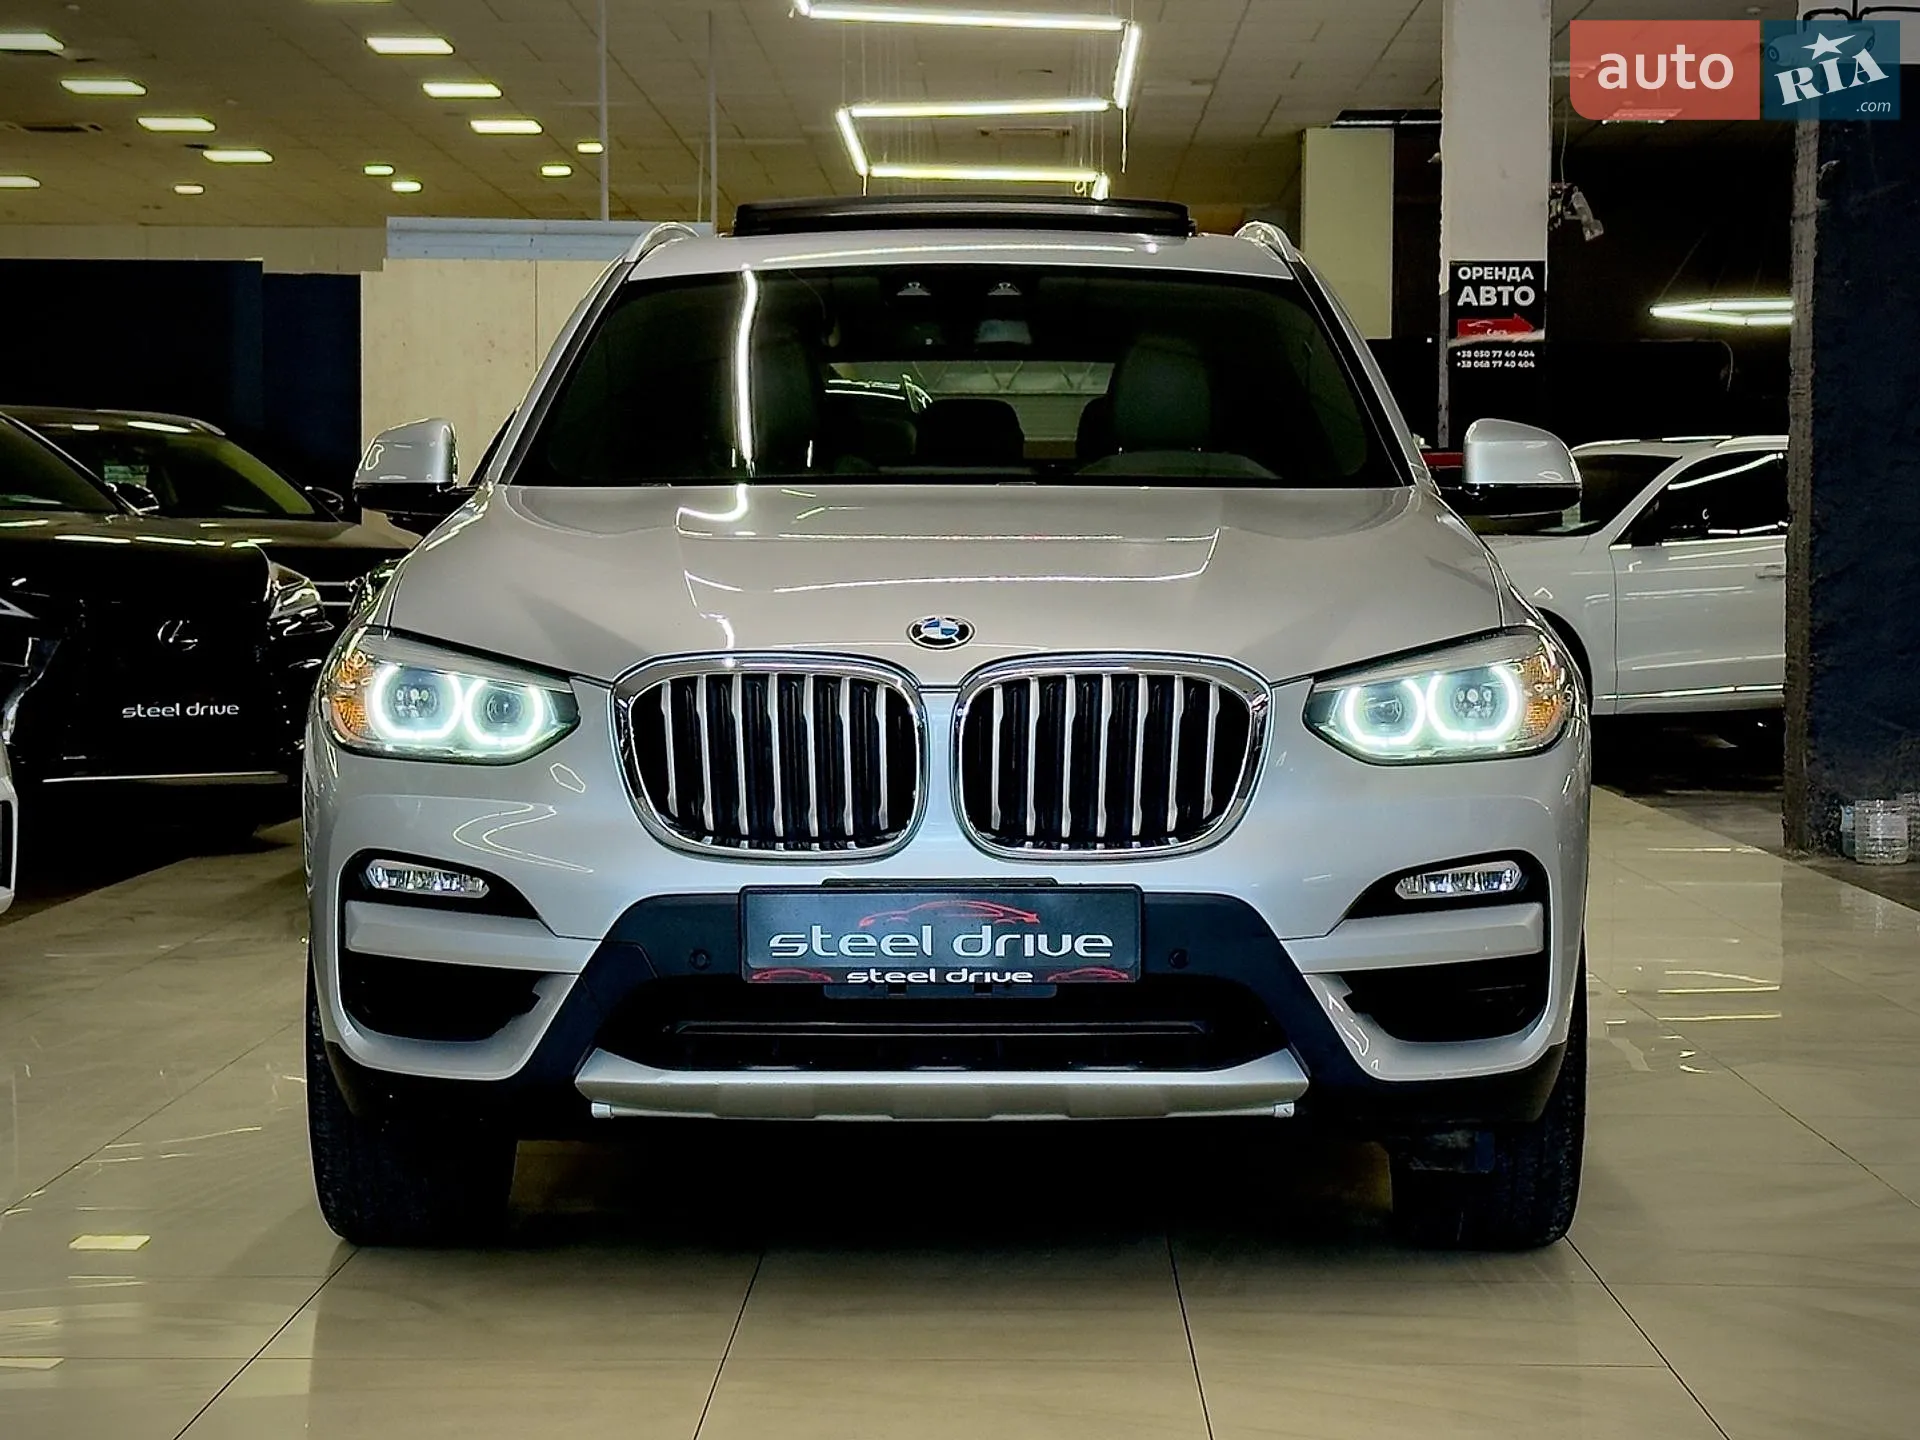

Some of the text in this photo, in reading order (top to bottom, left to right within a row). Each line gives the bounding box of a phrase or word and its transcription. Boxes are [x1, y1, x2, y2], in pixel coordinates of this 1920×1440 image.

[1457, 266, 1534, 282] ОРЕНДА
[1457, 285, 1535, 306] АВТО
[121, 702, 240, 718] steel drive
[768, 925, 1113, 957] steel drive
[846, 968, 1033, 983] steel drive
